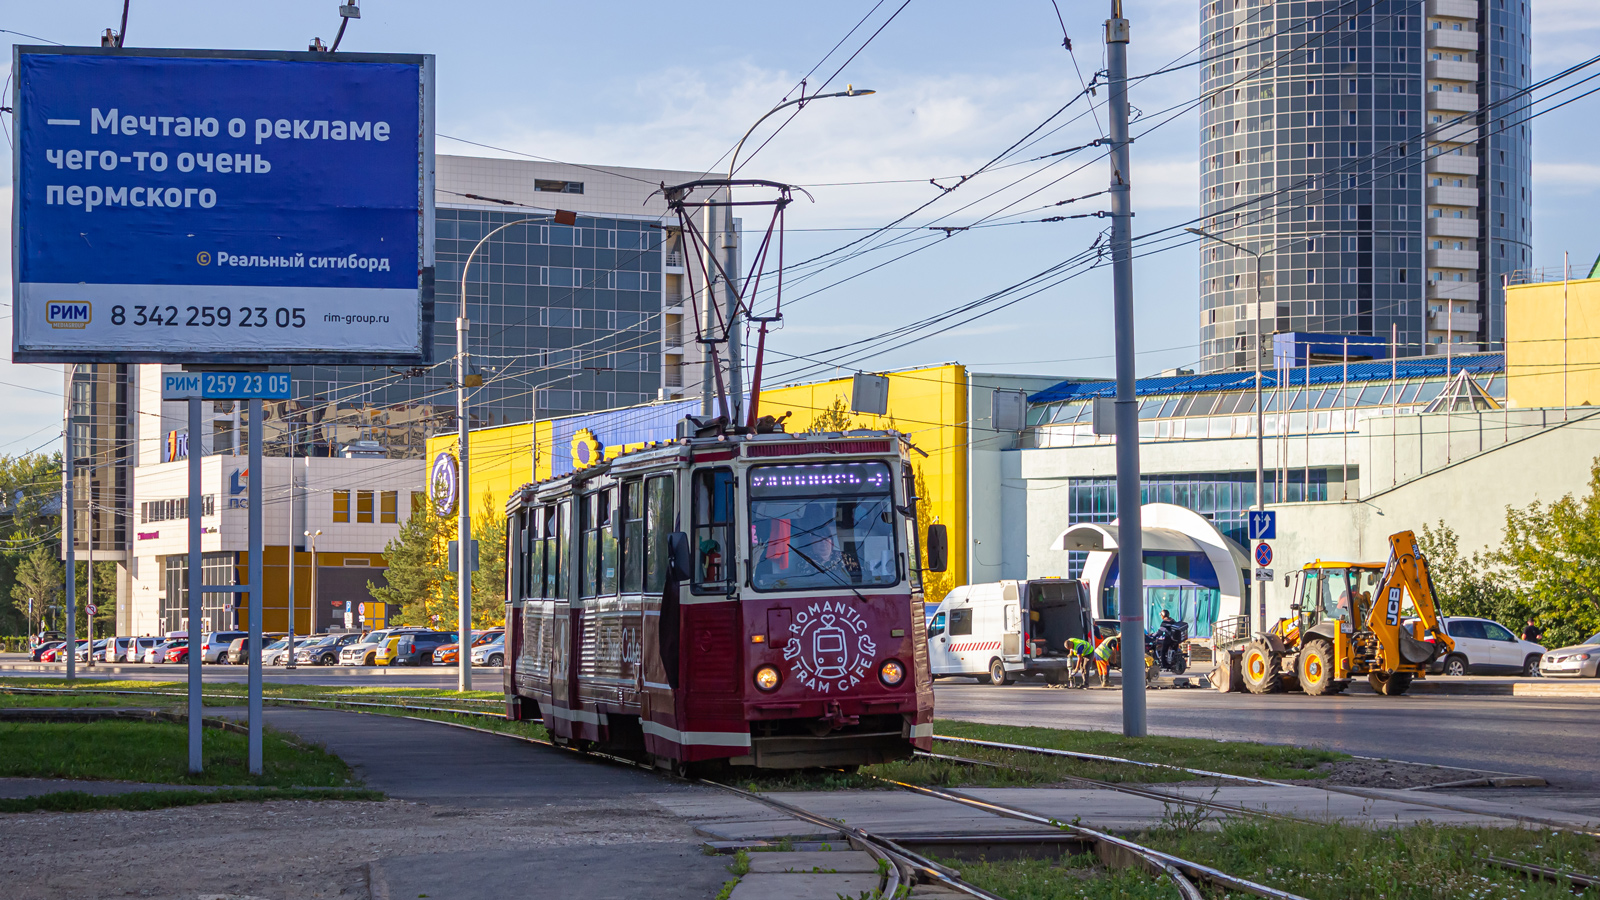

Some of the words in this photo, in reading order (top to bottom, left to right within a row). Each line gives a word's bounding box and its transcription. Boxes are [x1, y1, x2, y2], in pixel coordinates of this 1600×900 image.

[90, 107, 219, 138] Мечтаю
[227, 117, 246, 138] о
[255, 118, 391, 145] рекламе
[46, 149, 169, 172] чего-то
[176, 152, 272, 174] очень
[46, 185, 217, 213] пермского
[217, 251, 304, 269] Реальный
[308, 253, 391, 273] ситиборд
[50, 304, 88, 320] РИМ
[110, 304, 126, 326] 8
[133, 305, 179, 327] 342
[185, 305, 231, 327] 259
[239, 306, 268, 328] 23
[275, 307, 306, 329] 05
[323, 312, 390, 325] rim-group.ru
[165, 376, 198, 391] РИМ
[207, 375, 237, 393] 259
[243, 375, 262, 393] 23
[268, 375, 288, 393] 05
[229, 498, 248, 509] ПС
[789, 601, 867, 634] ROMANTIC
[1388, 588, 1400, 626] JCB
[790, 661, 830, 693] TRAM
[838, 658, 873, 691] CAFE
